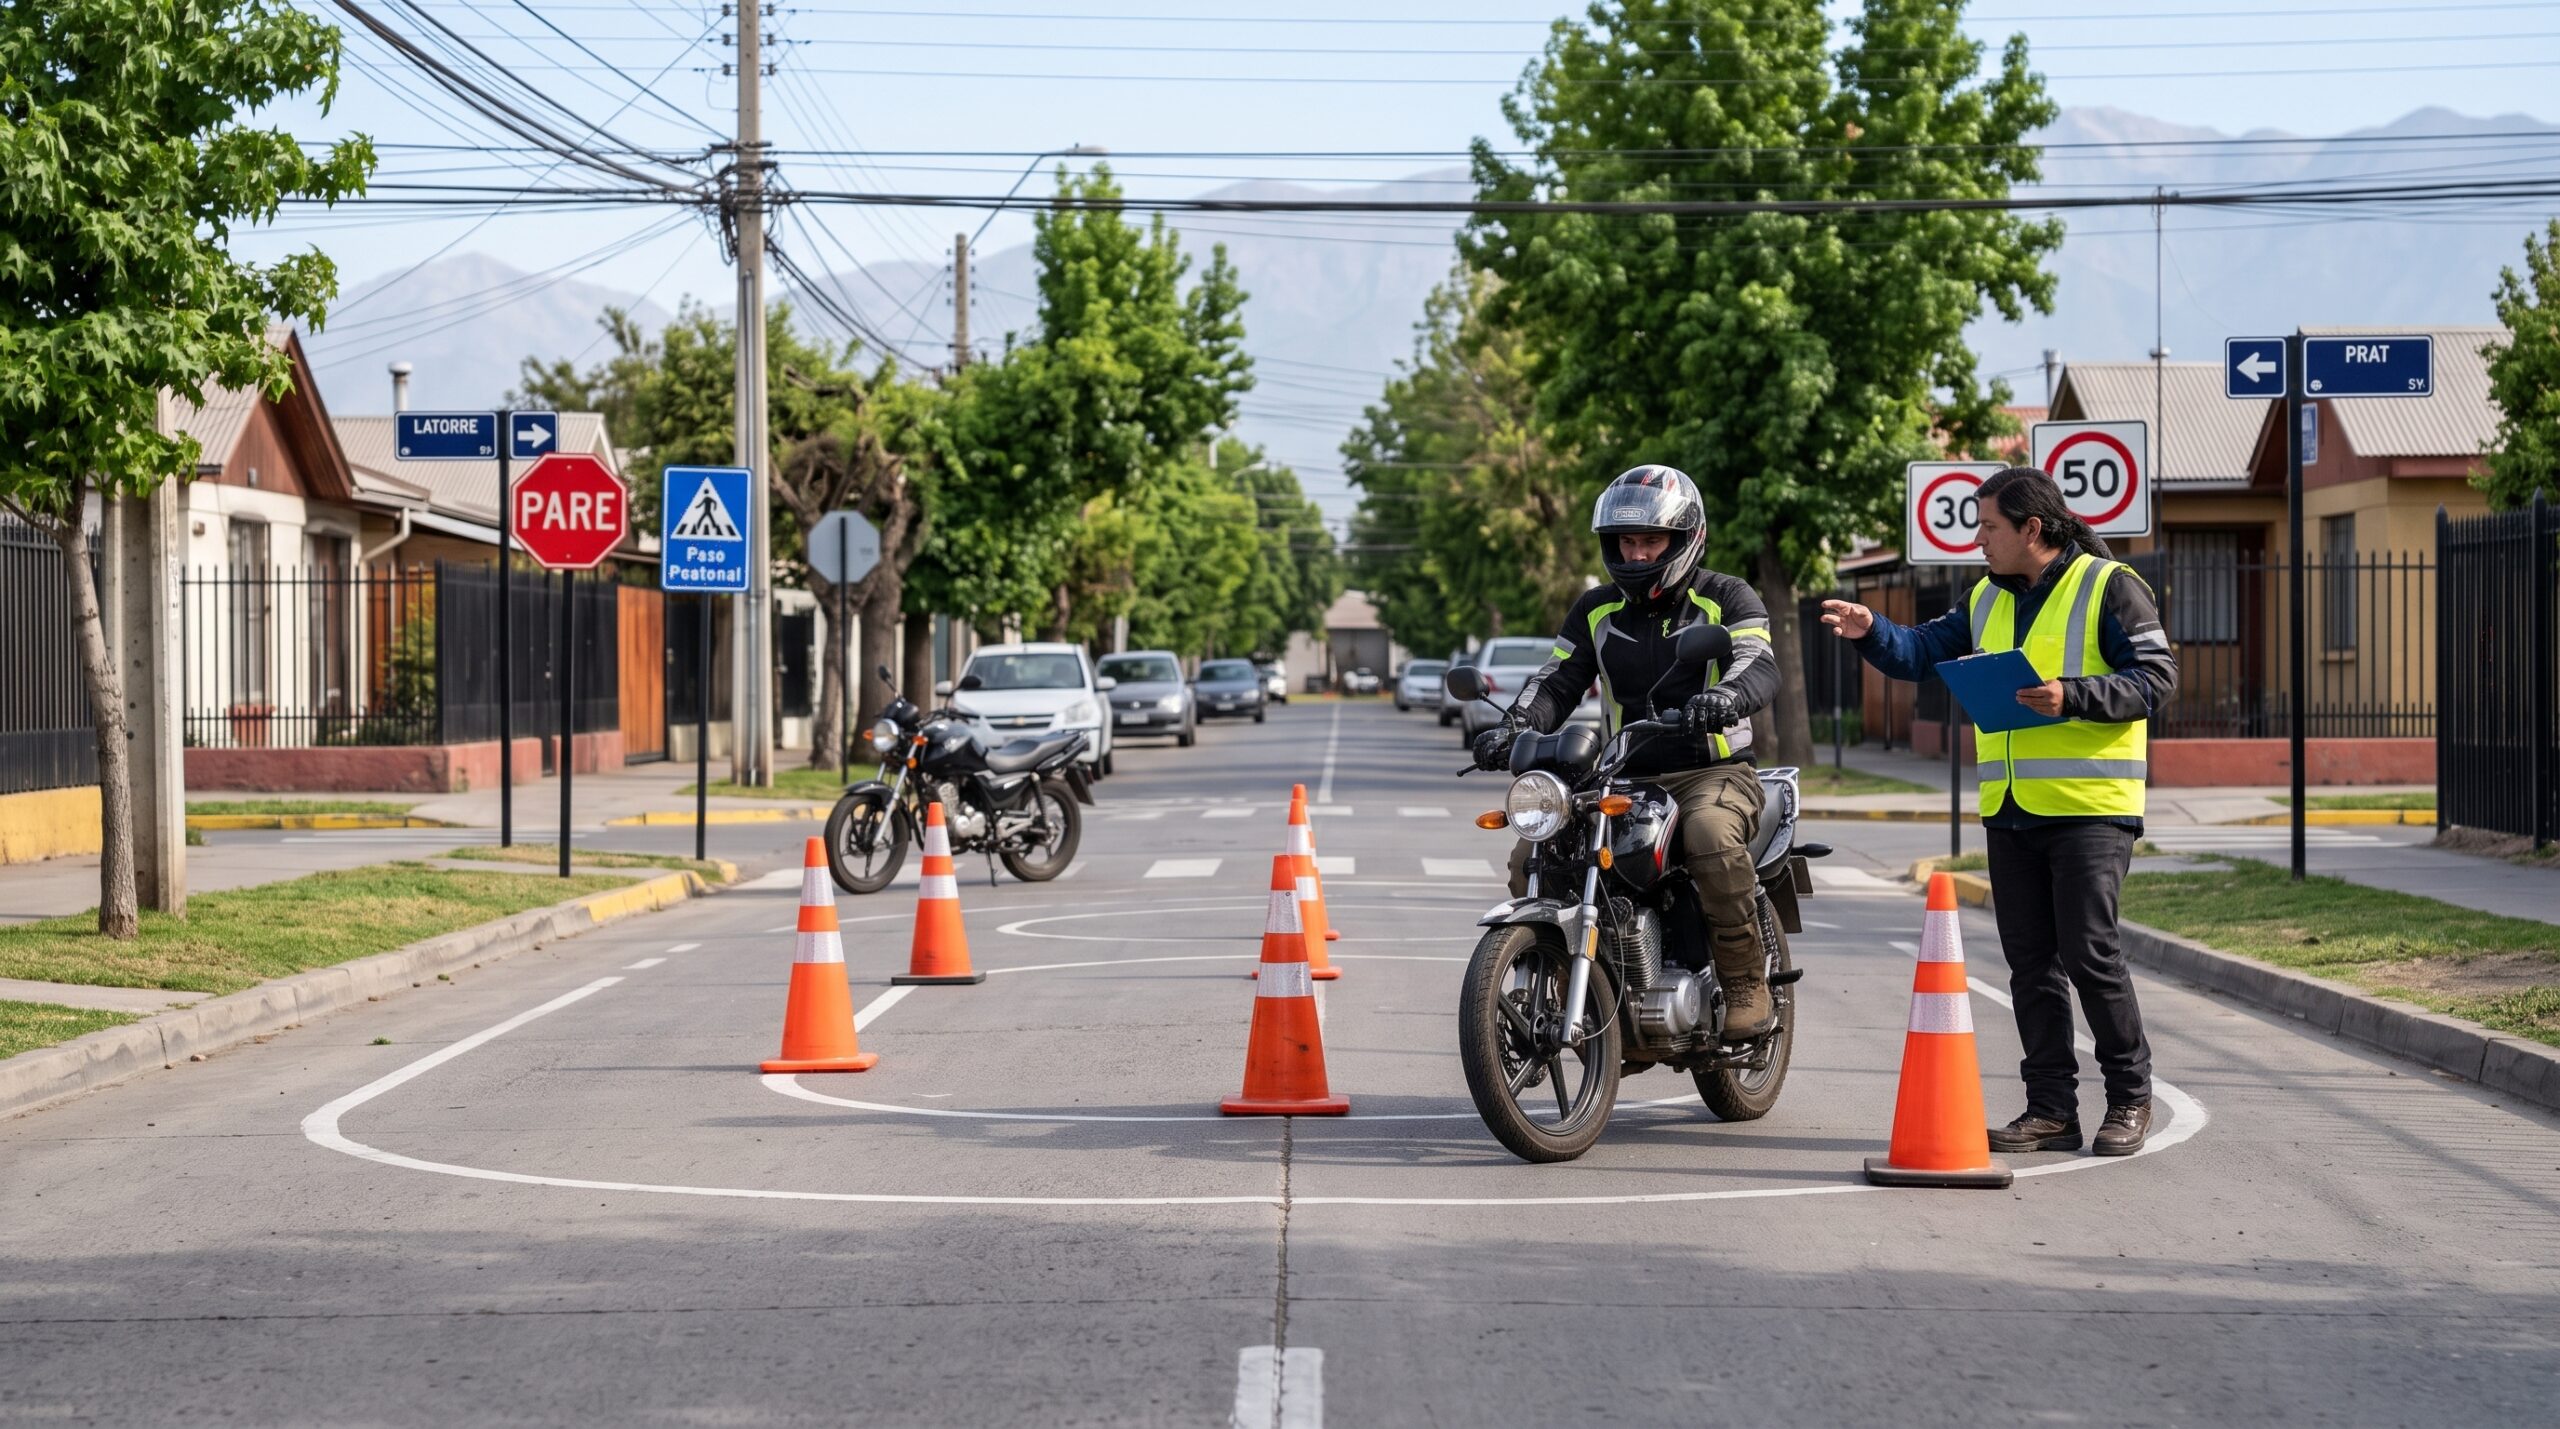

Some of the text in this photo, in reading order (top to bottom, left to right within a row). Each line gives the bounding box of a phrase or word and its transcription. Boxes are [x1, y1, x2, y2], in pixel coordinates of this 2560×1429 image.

[2345, 345, 2390, 363] PRAT
[413, 418, 479, 434] LATORRE
[2063, 458, 2120, 498] 50
[521, 491, 616, 531] PARE
[1934, 495, 1980, 530] 30
[686, 546, 726, 563] Paso
